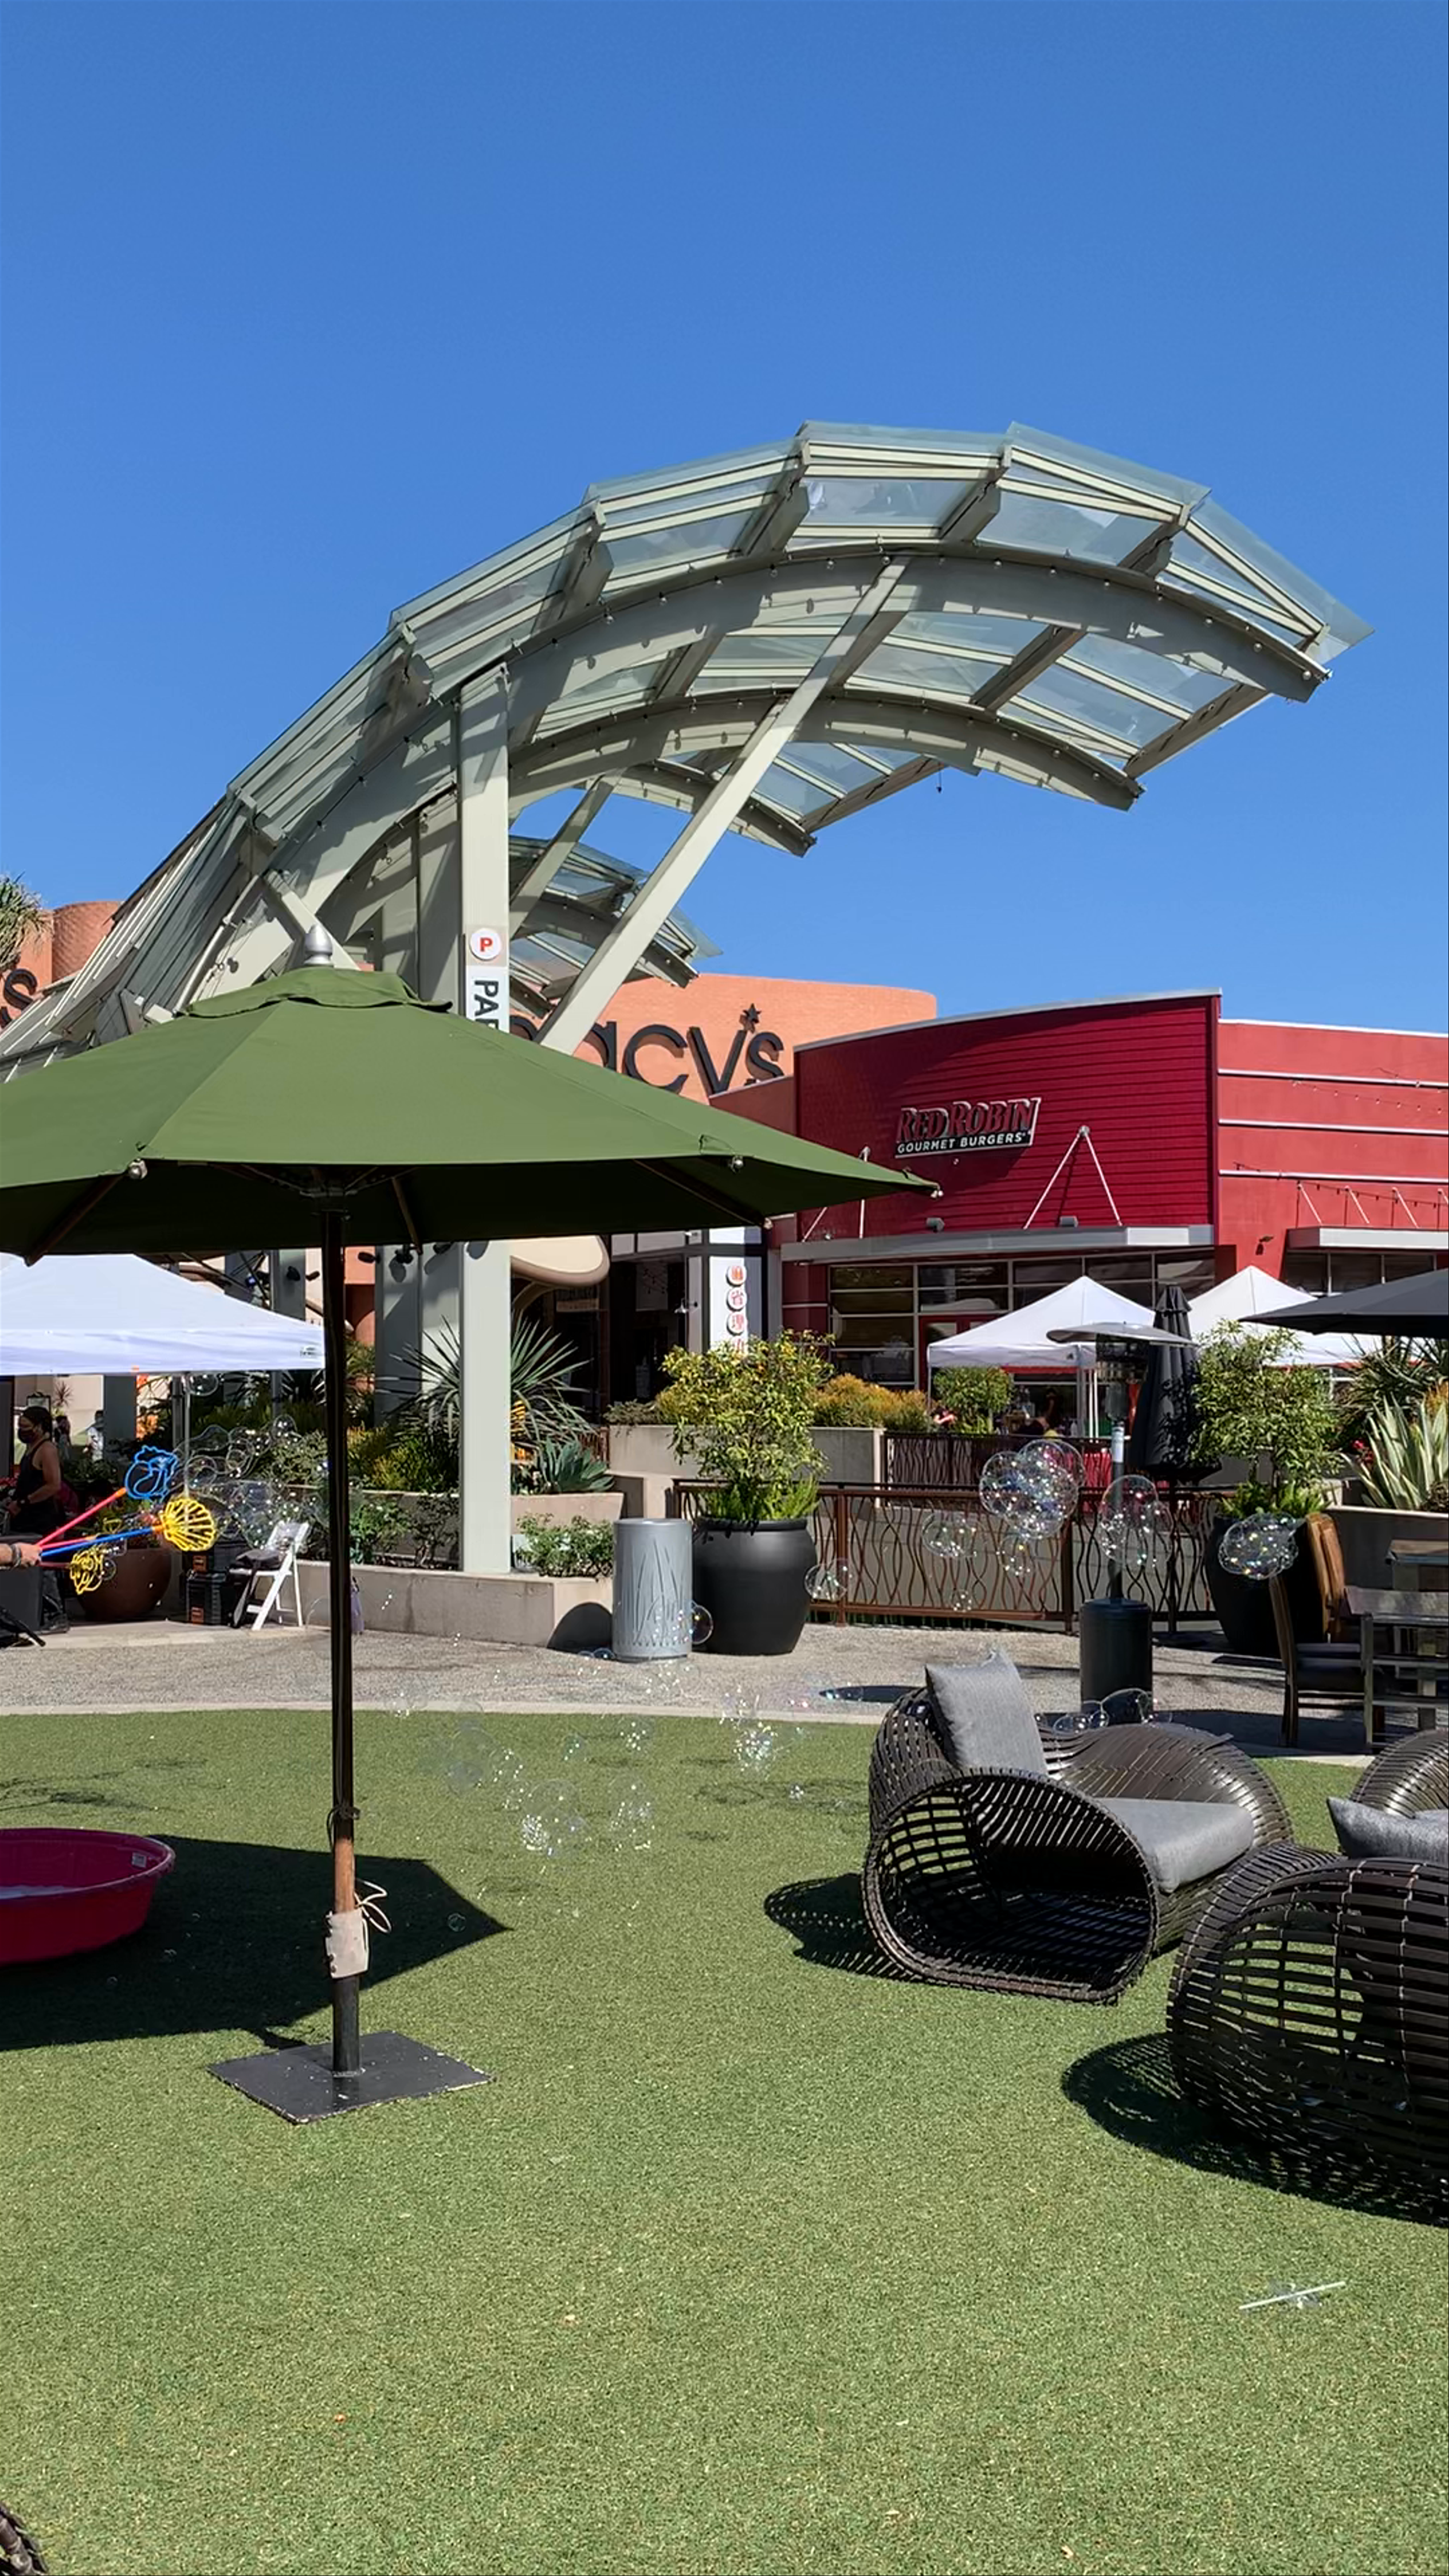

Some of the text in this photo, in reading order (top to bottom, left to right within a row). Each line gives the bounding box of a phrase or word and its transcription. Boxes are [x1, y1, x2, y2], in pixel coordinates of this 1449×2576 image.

[480, 937, 493, 952] P
[896, 1097, 1040, 1143] RED ROBIN
[897, 1139, 955, 1153] GOURMET
